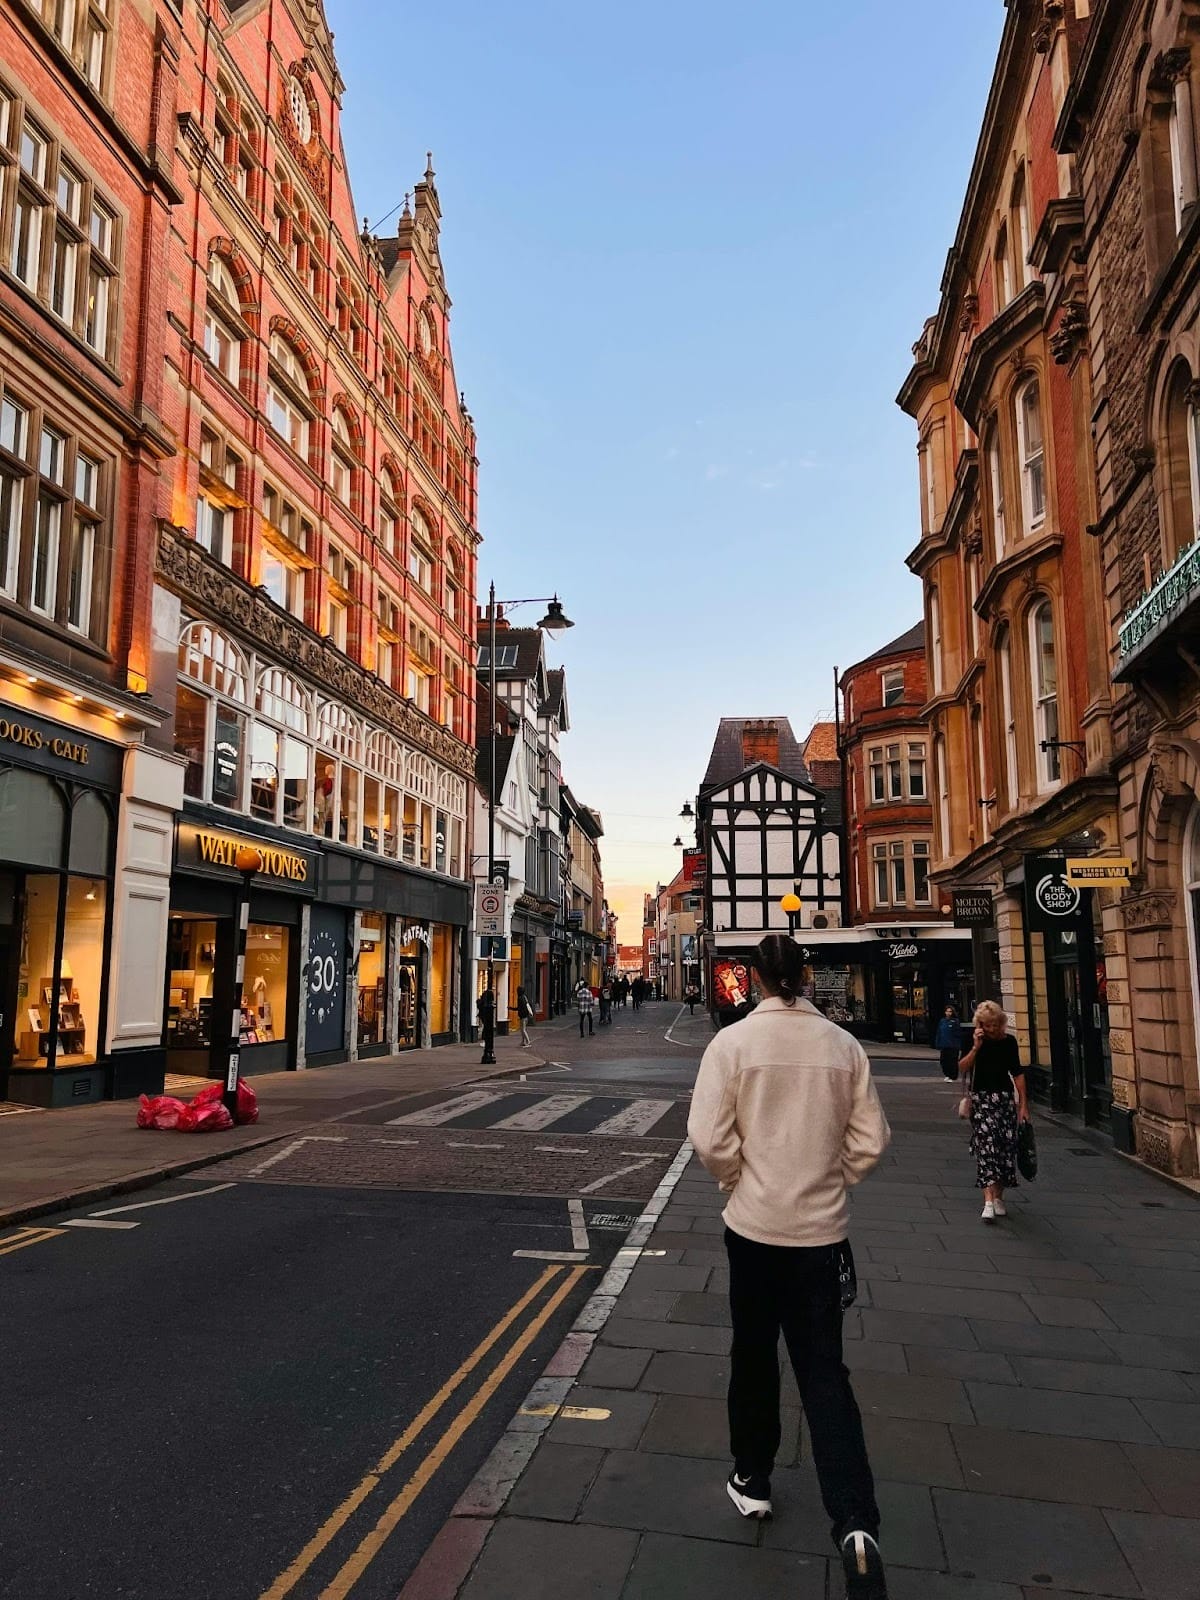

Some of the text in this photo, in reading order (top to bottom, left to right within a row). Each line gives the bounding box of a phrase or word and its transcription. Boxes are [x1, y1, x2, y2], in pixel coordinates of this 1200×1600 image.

[54, 738, 89, 764] CAFÉ
[1049, 885, 1066, 893] THE
[1044, 892, 1072, 901] BODY
[955, 897, 990, 907] MOLTON
[1046, 900, 1072, 908] SHOP
[956, 906, 990, 916] BROWN
[311, 955, 335, 992] 30
